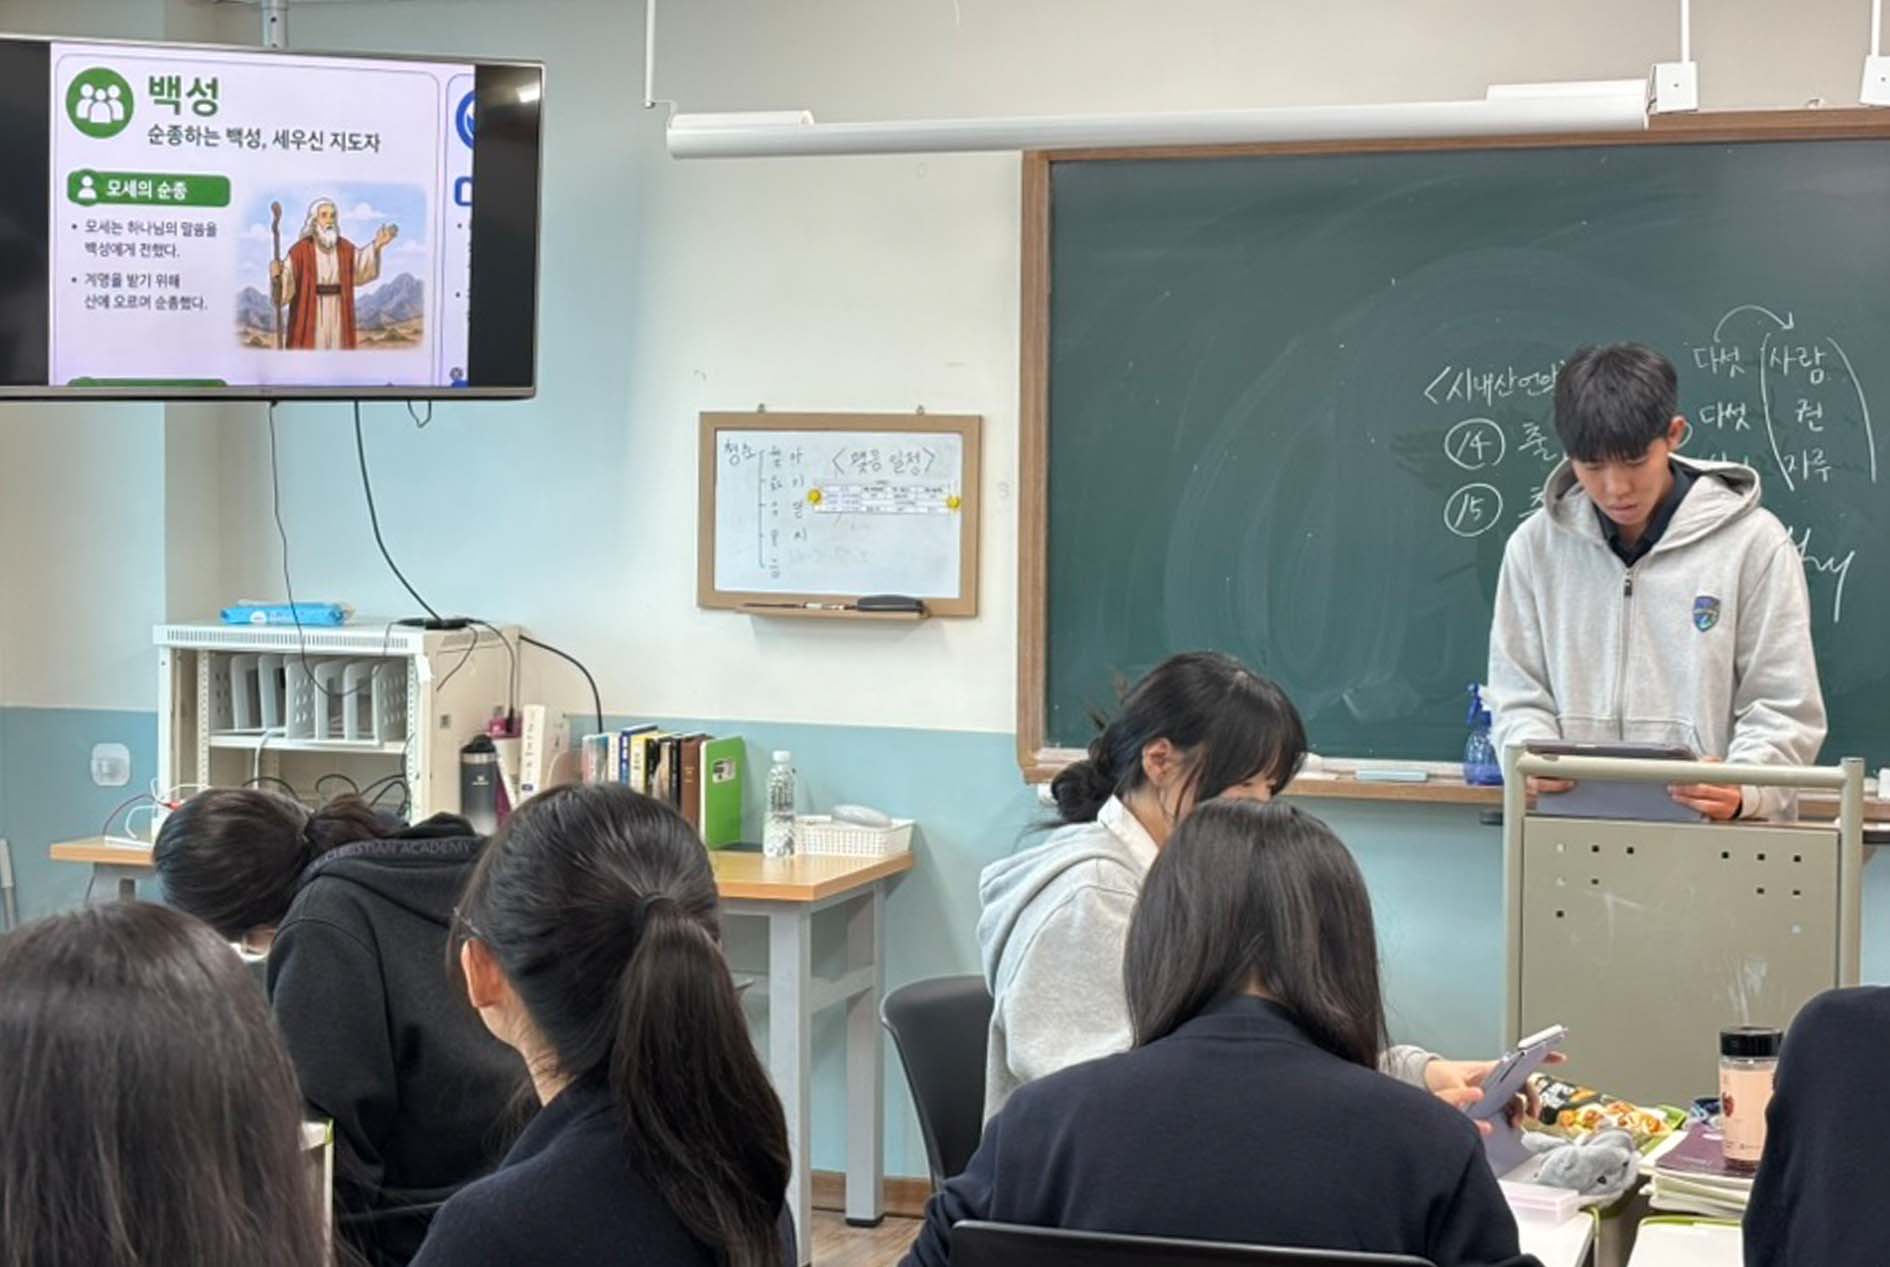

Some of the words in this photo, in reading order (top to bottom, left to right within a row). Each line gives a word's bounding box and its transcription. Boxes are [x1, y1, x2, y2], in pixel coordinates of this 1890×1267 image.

[148, 75, 219, 117] 백성
[148, 124, 221, 147] 순종하는
[226, 127, 266, 150] 백성,
[272, 129, 324, 152] 세우신
[330, 132, 380, 153] 지도자
[106, 179, 152, 198] 모세의
[157, 181, 187, 200] 순종
[85, 219, 122, 235] 모세는
[127, 220, 179, 237] 하나님의
[181, 221, 217, 238] 말씀을
[85, 242, 136, 258] 백성에게
[139, 242, 180, 258] 전했다.
[85, 272, 122, 289] 계명을
[126, 273, 151, 289] 받기
[156, 273, 180, 289] 위해
[85, 294, 110, 310] 산에
[113, 295, 151, 311] 오르며
[155, 295, 208, 312] 순종했다.
[1694, 345, 1745, 378] 다섯
[1700, 401, 1750, 431] 다섯
[1795, 398, 1824, 432] 권
[399, 840, 471, 856] ACADEMY
